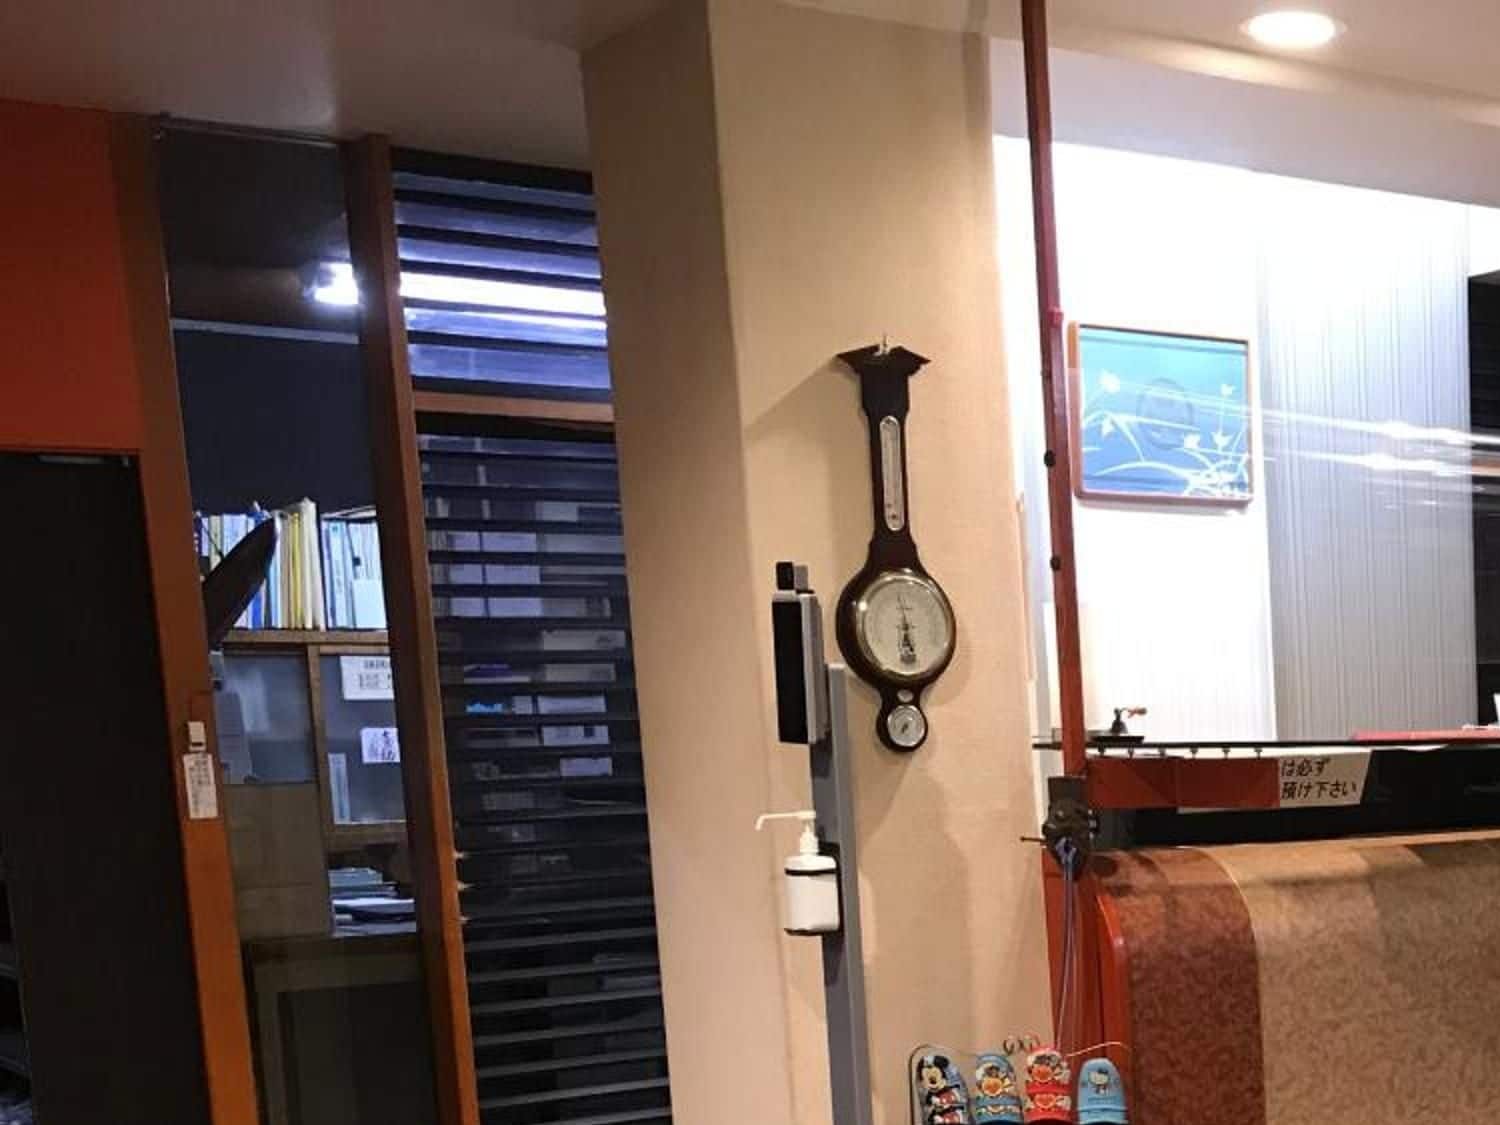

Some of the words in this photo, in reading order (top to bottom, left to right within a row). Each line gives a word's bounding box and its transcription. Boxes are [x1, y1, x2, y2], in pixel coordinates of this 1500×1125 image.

[1282, 758, 1330, 776] は必ず
[1282, 780, 1357, 799] 預け下さい
